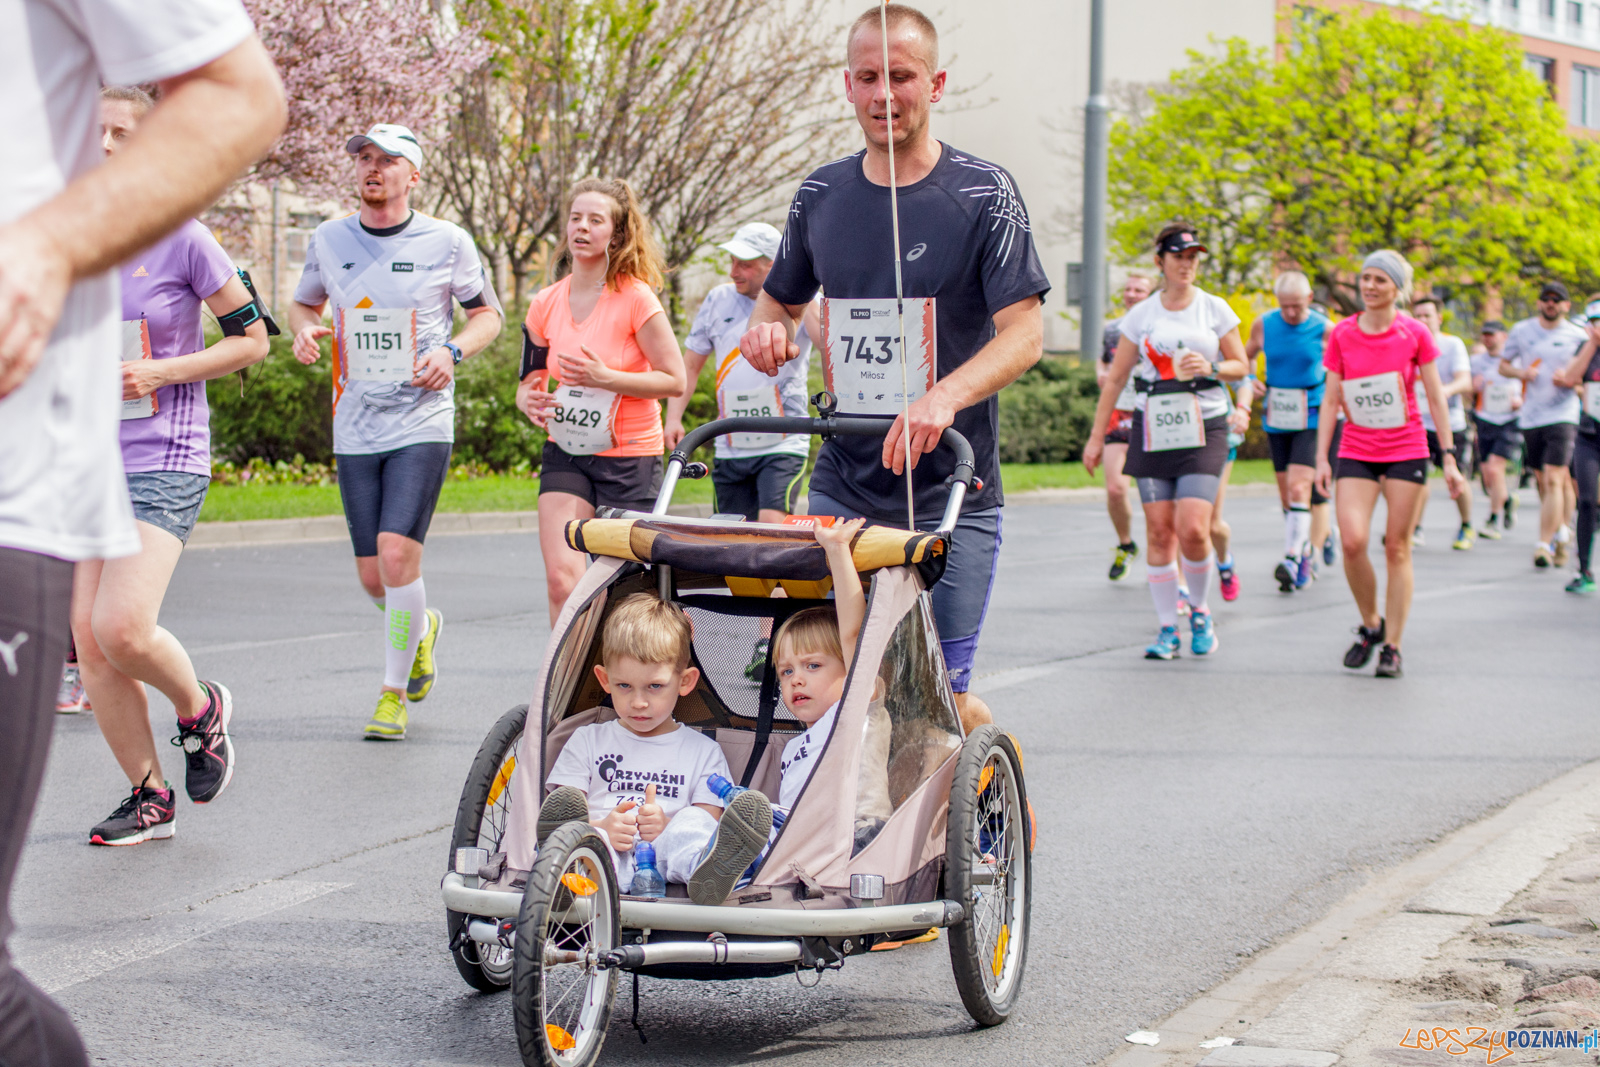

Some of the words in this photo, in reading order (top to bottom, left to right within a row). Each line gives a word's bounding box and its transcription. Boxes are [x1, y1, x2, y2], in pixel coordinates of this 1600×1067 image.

[354, 332, 402, 350] 11151
[840, 335, 907, 364] 7431
[860, 371, 886, 380] Miłosz
[1354, 391, 1394, 409] 9150
[553, 406, 602, 428] 8429
[1156, 411, 1190, 427] 5061
[608, 781, 679, 799] IEGCZE
